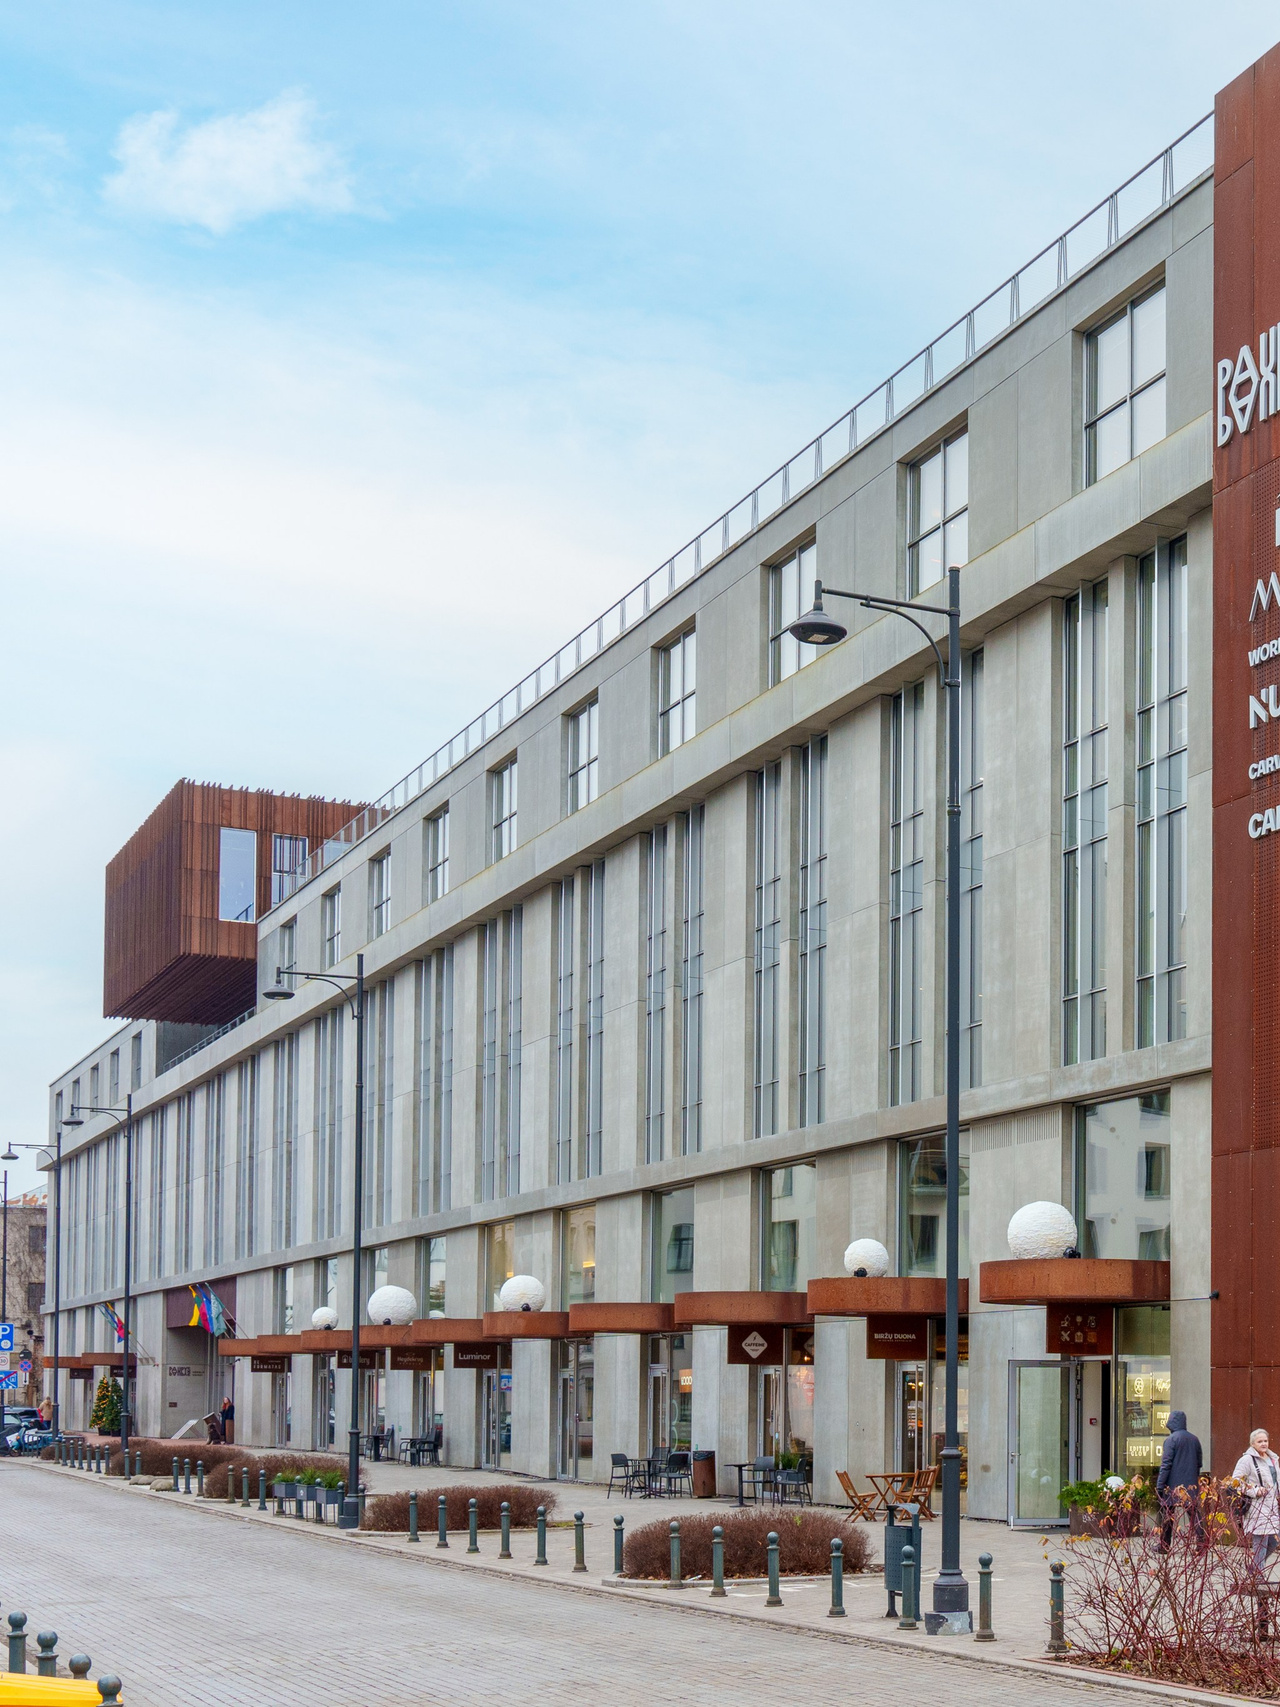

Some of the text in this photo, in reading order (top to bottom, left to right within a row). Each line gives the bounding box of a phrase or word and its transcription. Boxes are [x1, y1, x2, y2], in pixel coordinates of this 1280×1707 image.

[0, 1325, 11, 1339] P
[874, 1332, 893, 1340] BIRŽŲ
[458, 1352, 491, 1360] Luminor
